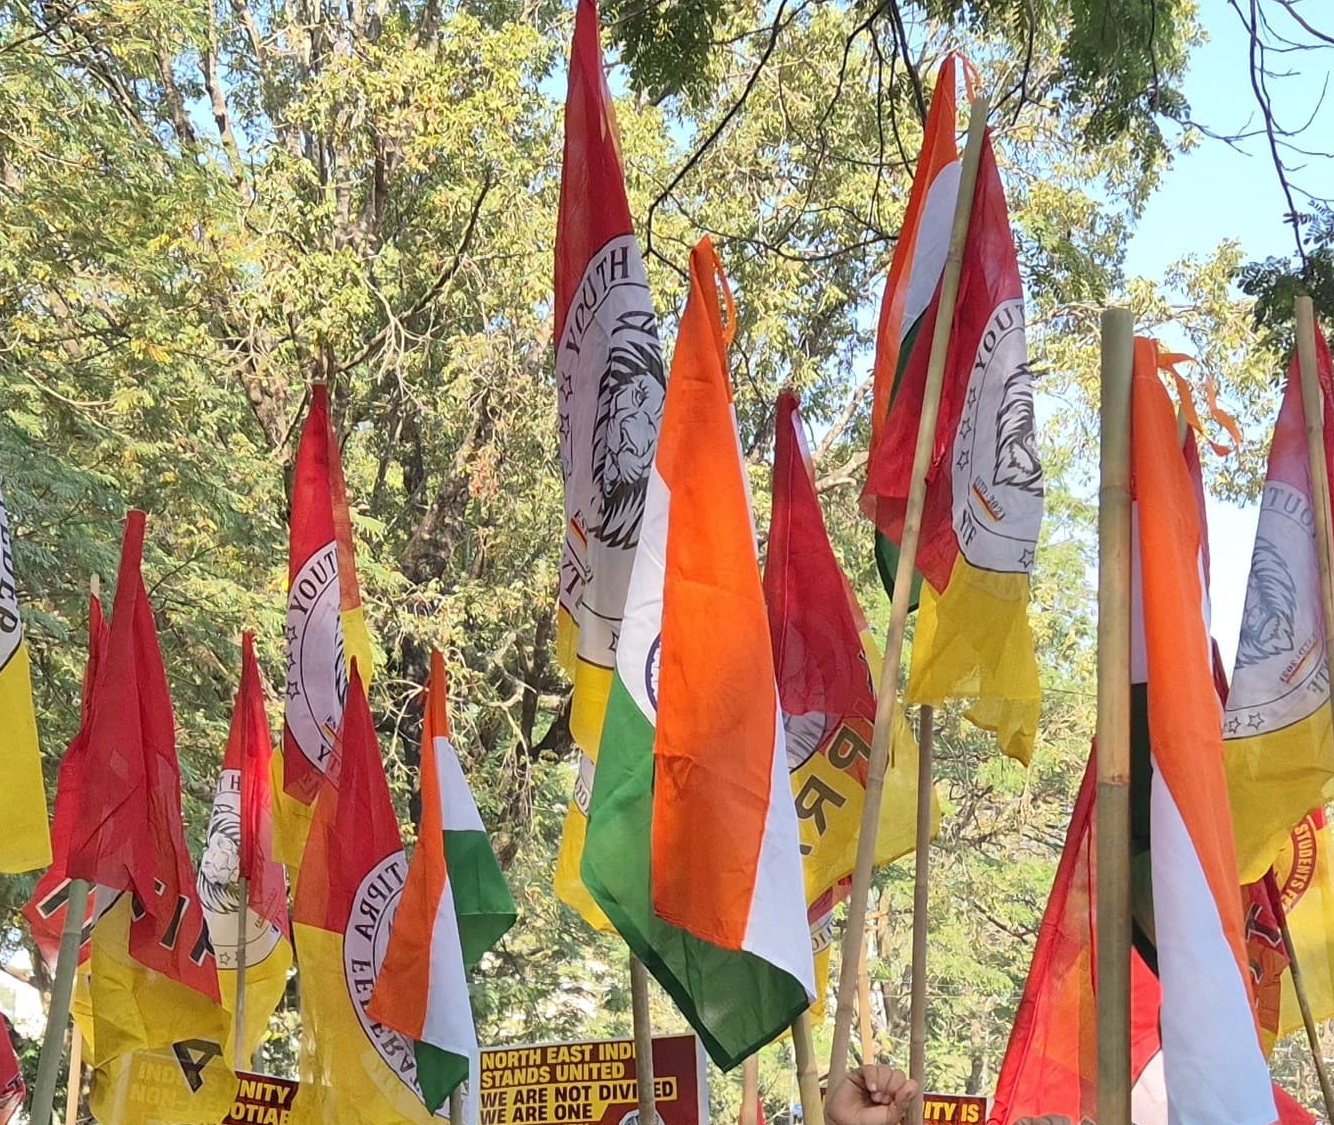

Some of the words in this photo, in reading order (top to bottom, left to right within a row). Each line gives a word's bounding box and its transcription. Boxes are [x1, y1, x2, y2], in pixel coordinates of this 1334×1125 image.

[566, 247, 629, 353] YOUTH
[1295, 823, 1312, 888] STUDENTS
[482, 1052, 541, 1070] NORTH
[547, 1047, 592, 1063] EAST
[482, 1067, 550, 1089] STANDS
[555, 1062, 625, 1081] UNITED
[481, 1092, 507, 1108] WE
[513, 1088, 547, 1105] ARE
[555, 1085, 591, 1102] NOT
[600, 1081, 673, 1101] DIVIED
[480, 1108, 506, 1125] WE
[513, 1105, 547, 1122] ARE
[554, 1103, 592, 1120] ONE
[961, 1103, 979, 1122] IS
